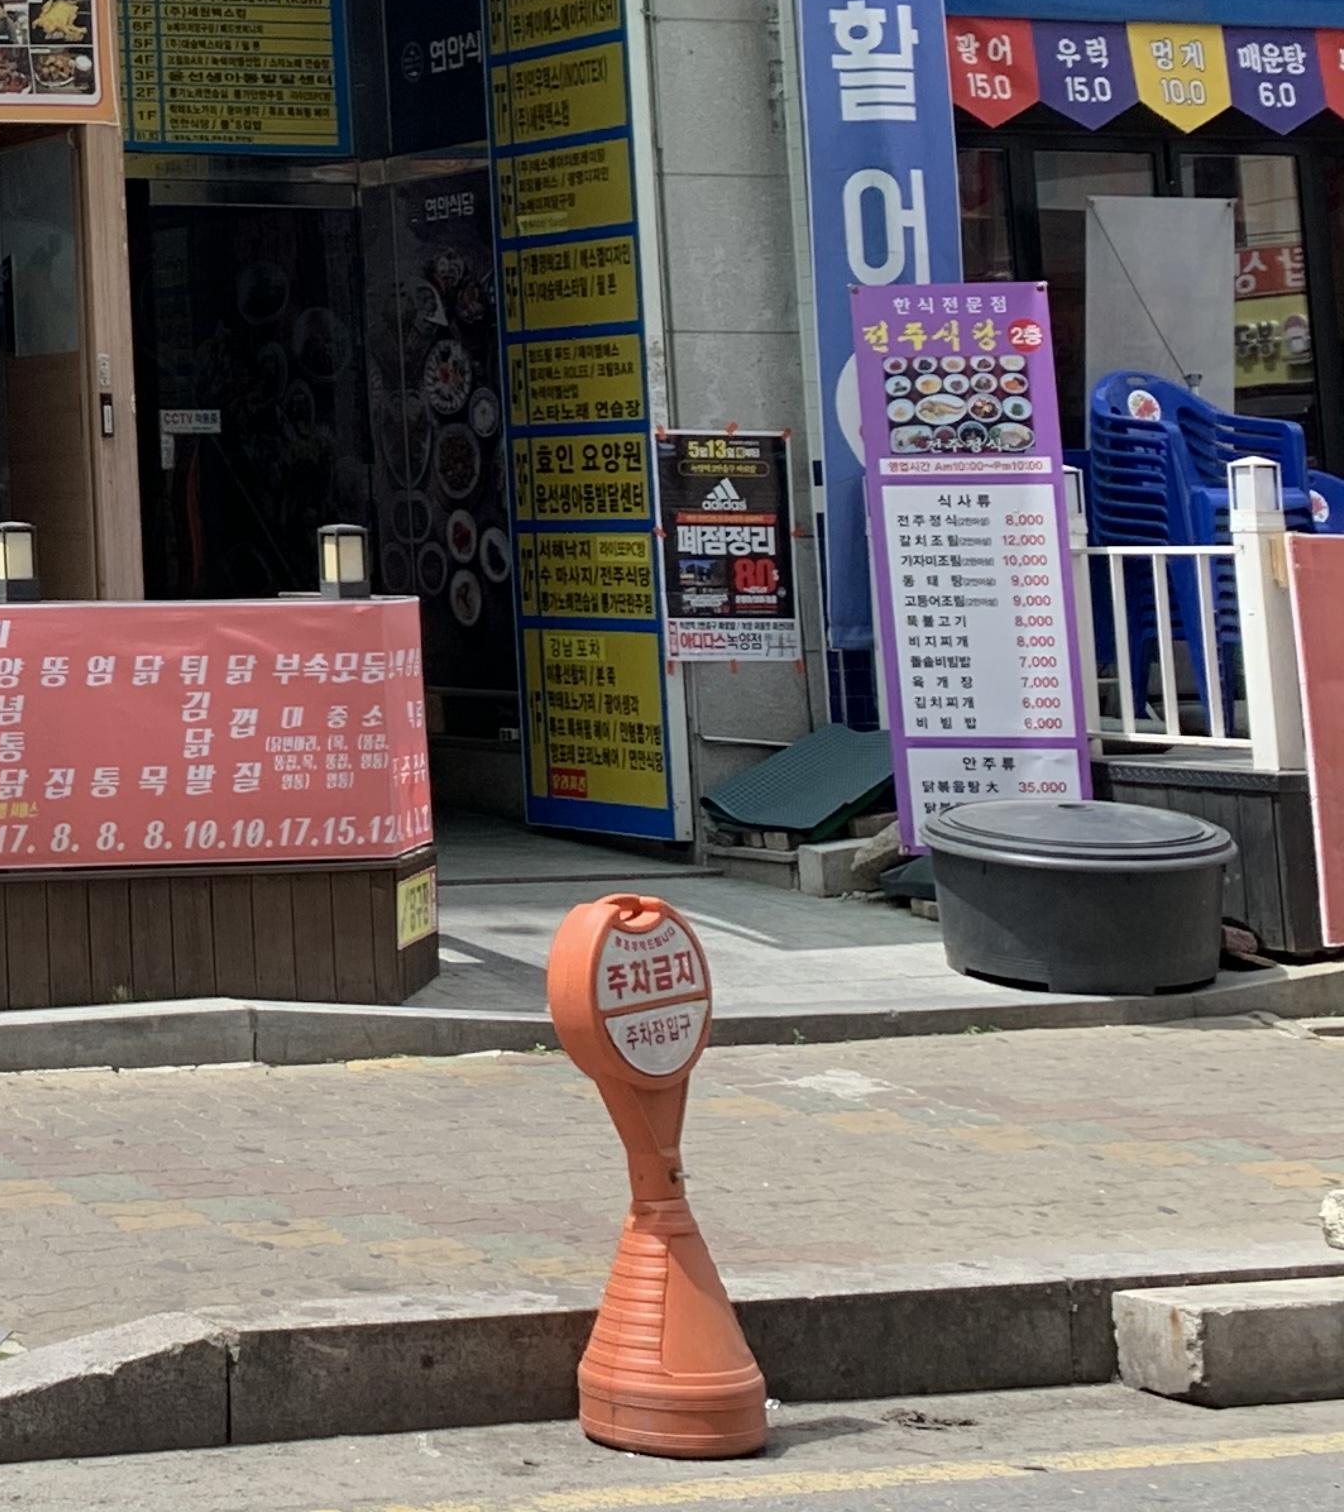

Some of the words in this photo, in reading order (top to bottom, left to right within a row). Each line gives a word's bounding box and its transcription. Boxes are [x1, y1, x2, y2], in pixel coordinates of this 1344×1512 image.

[956, 35, 1013, 66] 광어
[1056, 36, 1109, 69] 우럭
[1150, 40, 1206, 71] 멍게
[1237, 42, 1307, 75] 매운탕
[967, 72, 1012, 100] 15.0
[1065, 74, 1112, 102] 15.0
[1159, 79, 1206, 106] 10.0
[1259, 82, 1297, 109] 6.0
[892, 295, 1008, 315] 한식전문점
[862, 318, 1002, 353] 전주식당
[535, 444, 575, 475] 효인
[581, 440, 643, 474] 요양원
[701, 498, 748, 511] adidas
[937, 492, 992, 509] 식사류
[677, 525, 777, 557] 폐점정리
[961, 756, 1017, 771] 안주류
[606, 949, 696, 1000] 주차금지
[625, 1013, 692, 1051] 주차장입구
